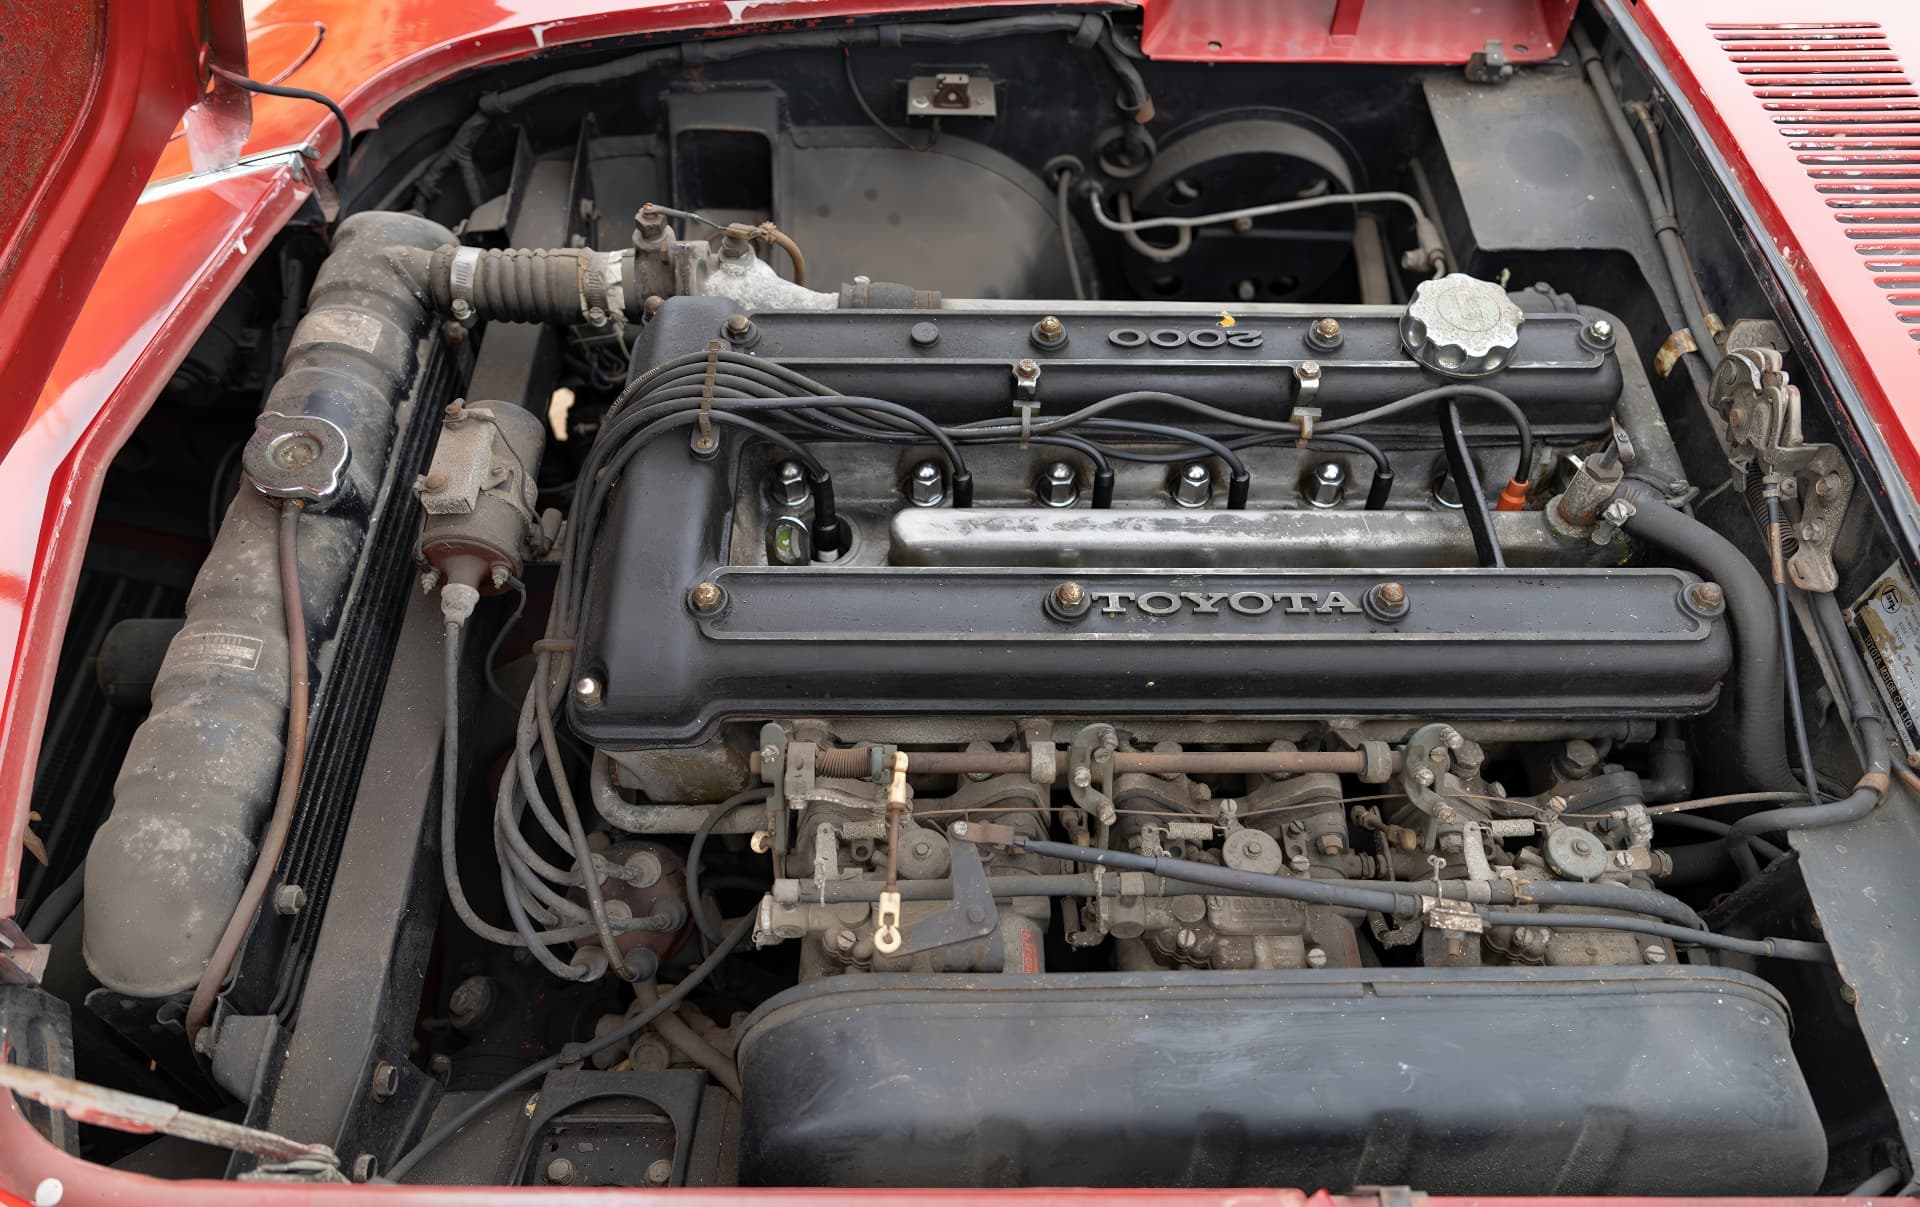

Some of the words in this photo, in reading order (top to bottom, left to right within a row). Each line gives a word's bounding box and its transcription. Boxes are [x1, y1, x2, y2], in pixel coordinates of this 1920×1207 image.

[1108, 328, 1264, 348] 2000
[1091, 591, 1362, 614] TOYOTA
[1863, 635, 1883, 666] TOYOTA
[1878, 666, 1897, 693] MOTOR
